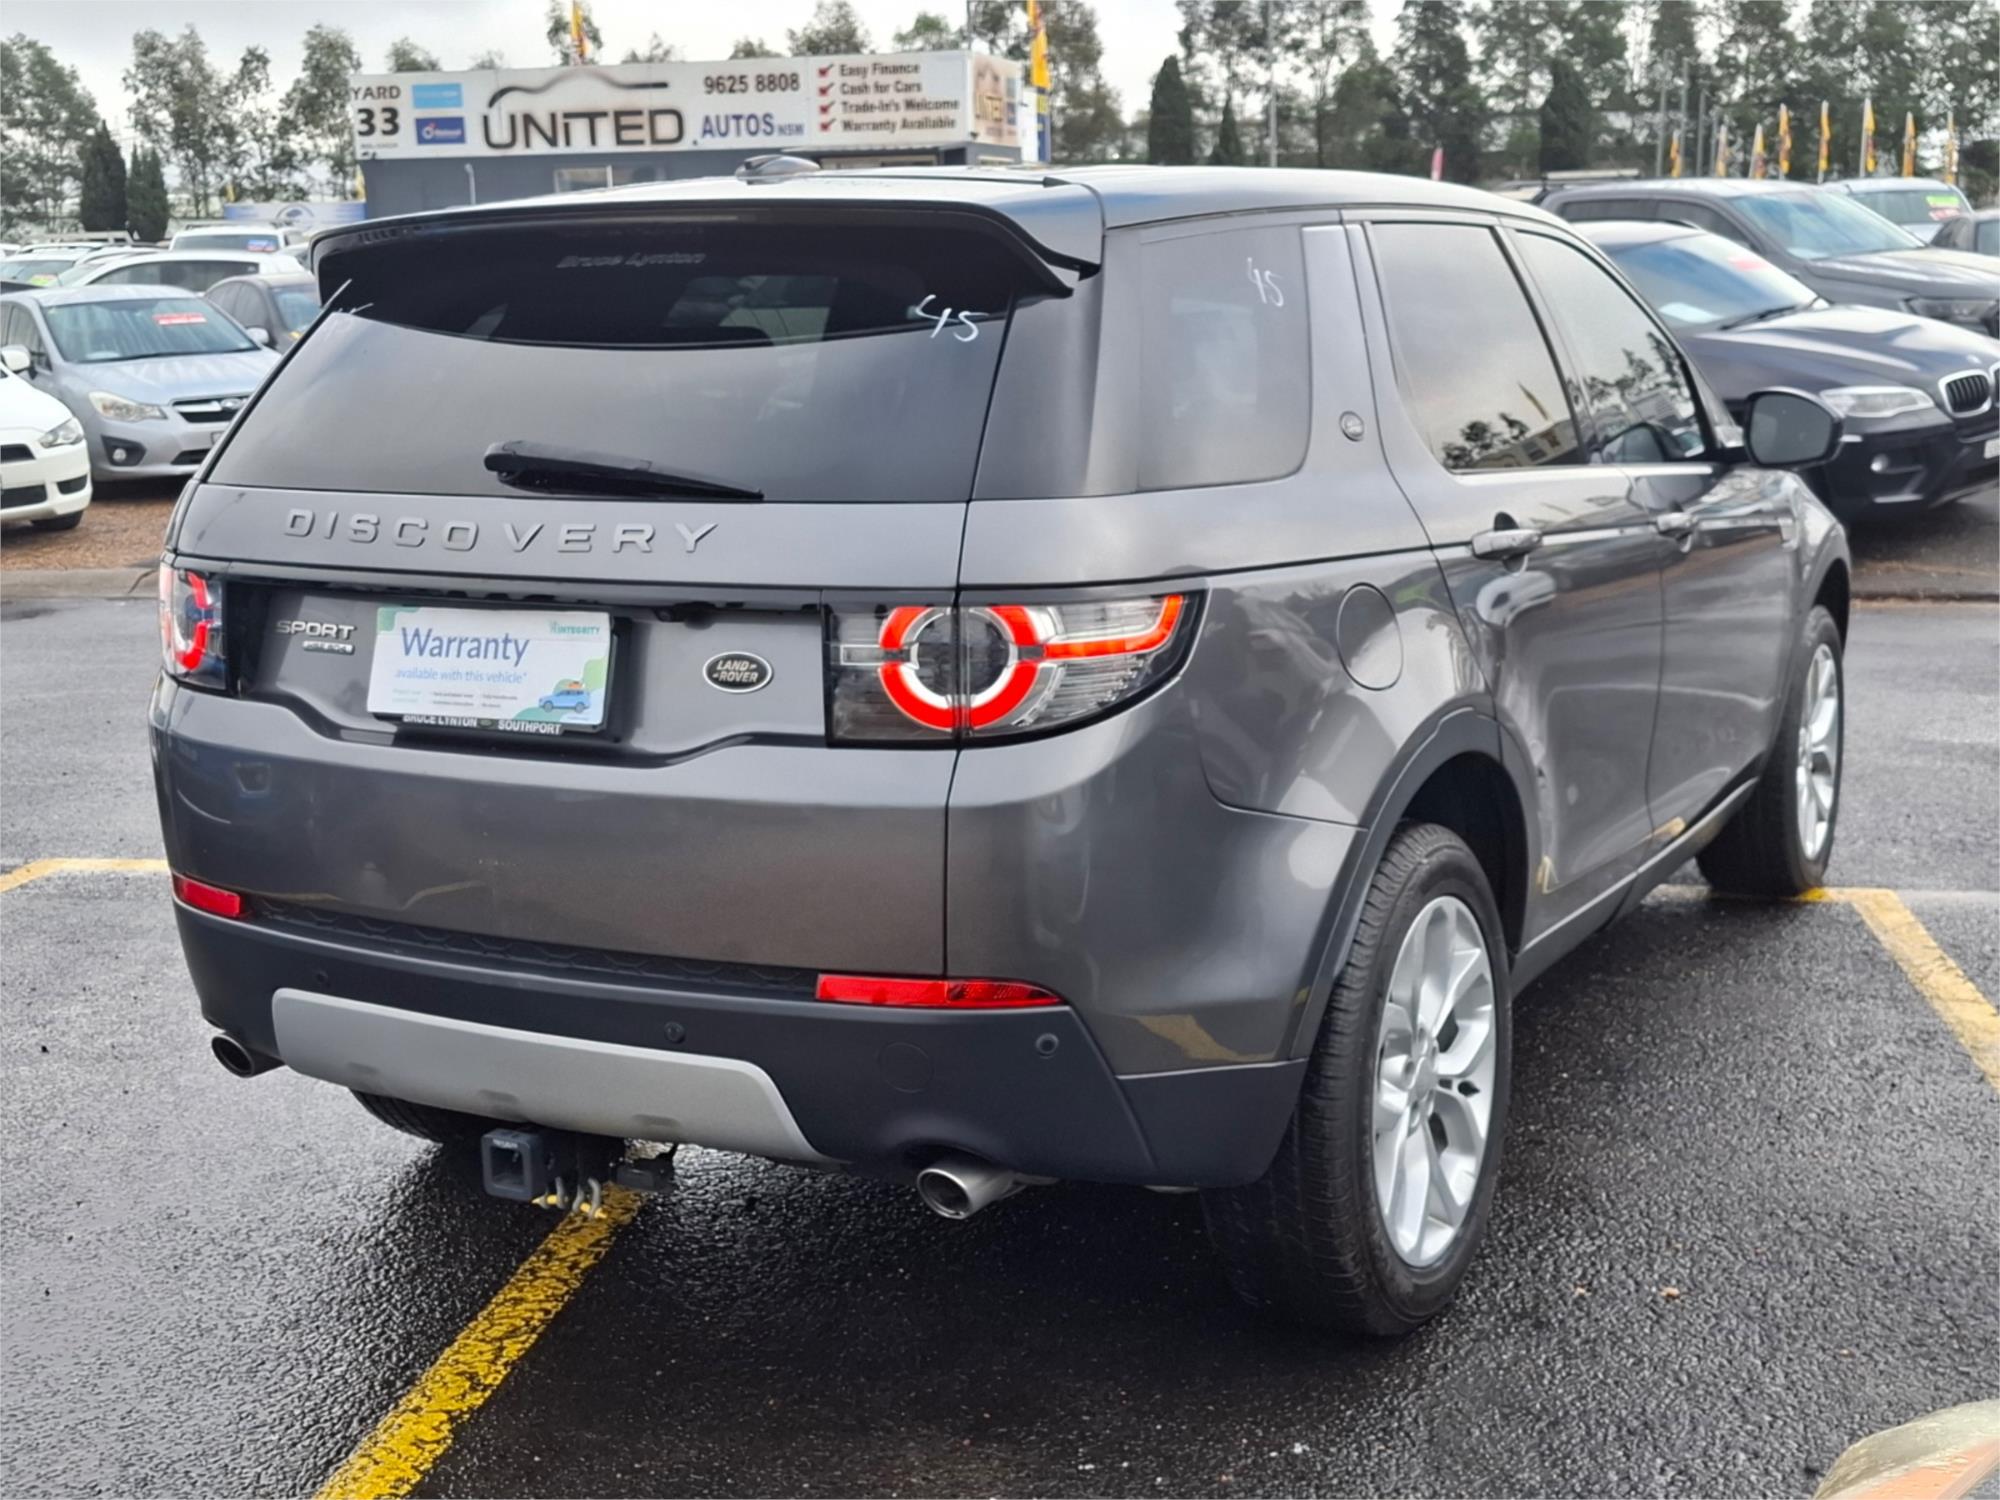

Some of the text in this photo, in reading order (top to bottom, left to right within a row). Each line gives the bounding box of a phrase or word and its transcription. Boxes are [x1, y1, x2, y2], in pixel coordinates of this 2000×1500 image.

[839, 62, 920, 79] Easy Finance
[352, 86, 401, 101] YARD
[703, 72, 800, 95] 9625 8808
[840, 79, 922, 95] Cash for Cars
[904, 97, 959, 111] Welcome
[357, 107, 399, 137] 33
[702, 112, 774, 139] AUTOS
[842, 116, 956, 133] Warranty Available
[1246, 256, 1285, 307] 45
[914, 293, 990, 342] 45
[284, 507, 719, 553] DISCOVERY
[276, 620, 357, 640] SPORT
[400, 626, 530, 667] Warranty
[394, 667, 438, 680] available
[440, 668, 462, 681] with
[465, 669, 484, 682] this
[498, 719, 562, 735] SOUTHPORT
